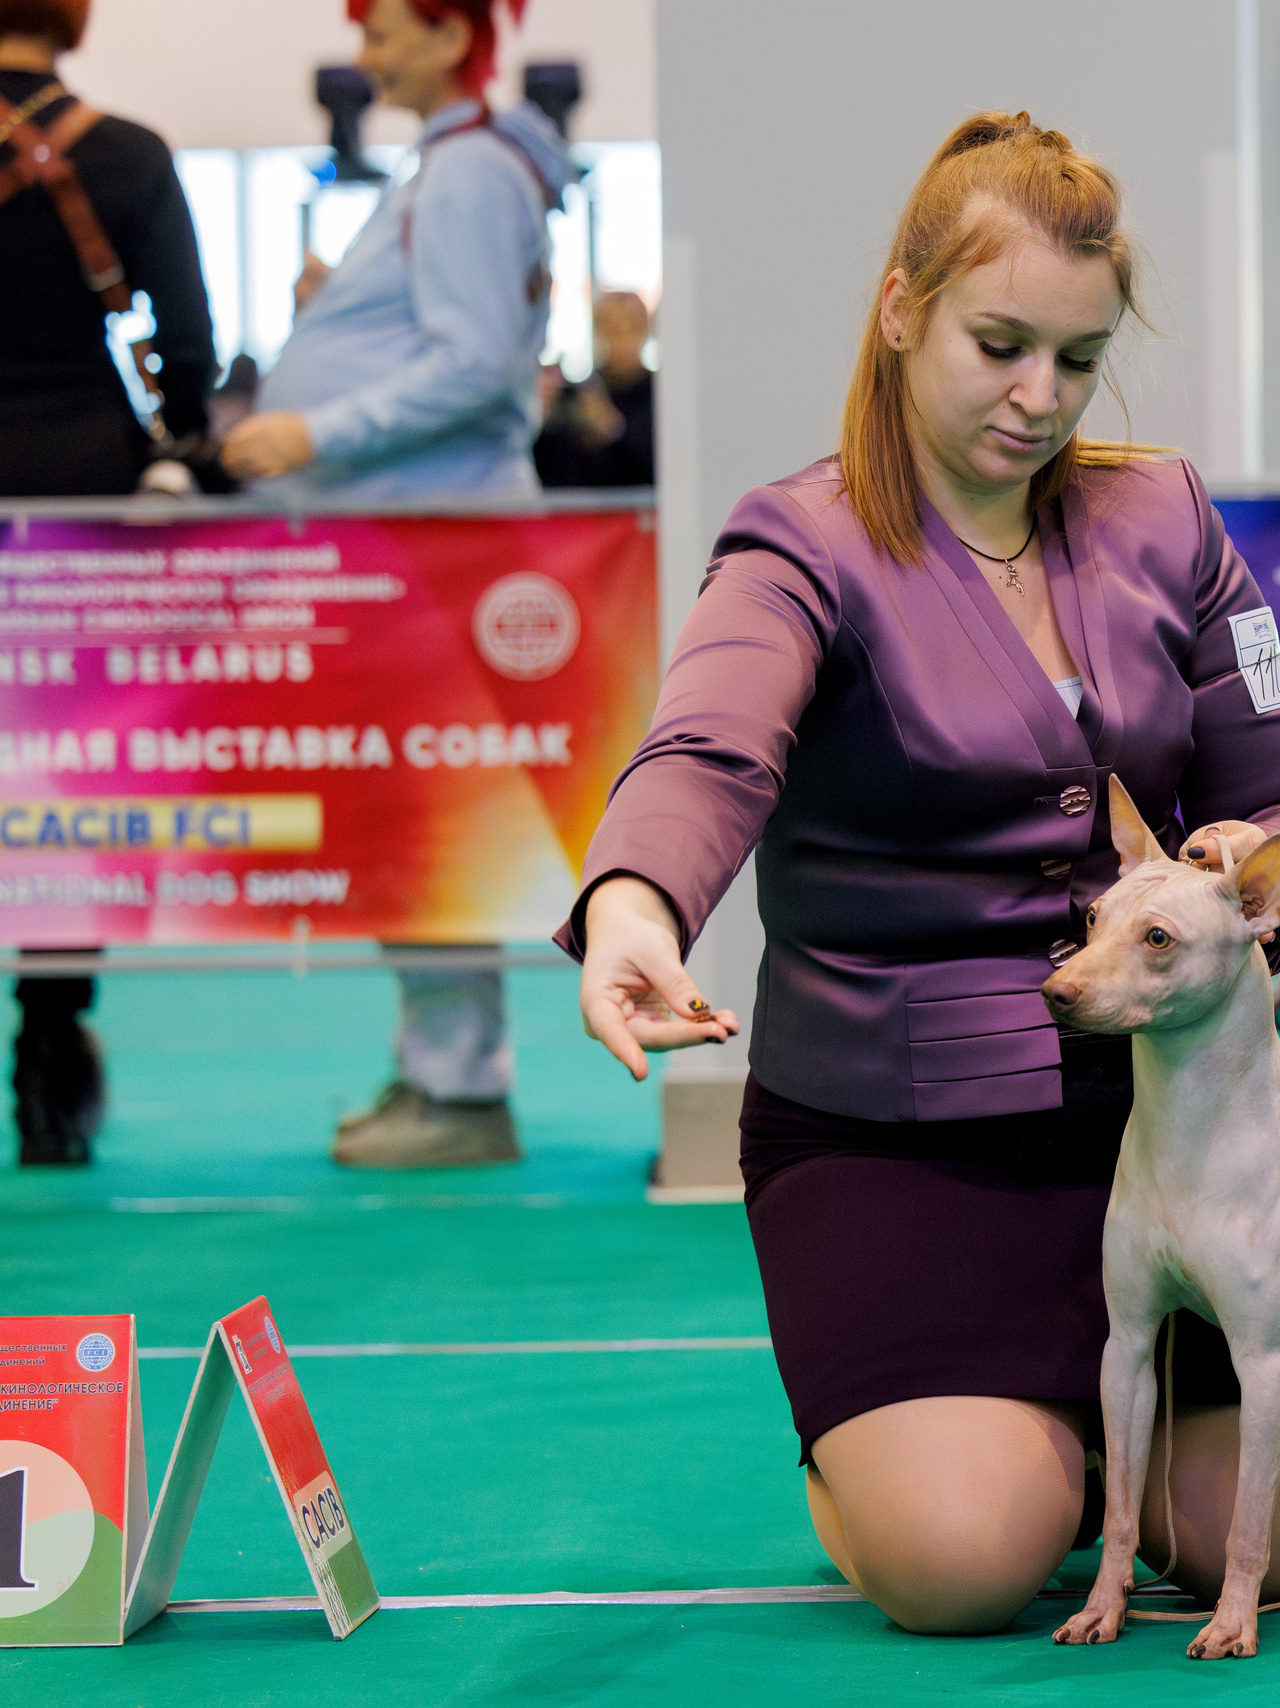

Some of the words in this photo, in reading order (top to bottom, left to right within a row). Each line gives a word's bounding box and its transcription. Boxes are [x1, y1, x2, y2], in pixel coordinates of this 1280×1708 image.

[106, 643, 314, 685] BELARUS
[128, 725, 393, 772] ВЫСТАВКА
[402, 722, 573, 769] СОБАК
[0, 806, 151, 849] CACIB
[173, 804, 250, 846] FCI
[155, 869, 239, 907] DOG
[244, 867, 349, 907] SHOW
[0, 1382, 123, 1396] КИНОЛОГИЧЕСКОЕ
[0, 1466, 38, 1591] 1
[300, 1485, 347, 1551] CACIB
